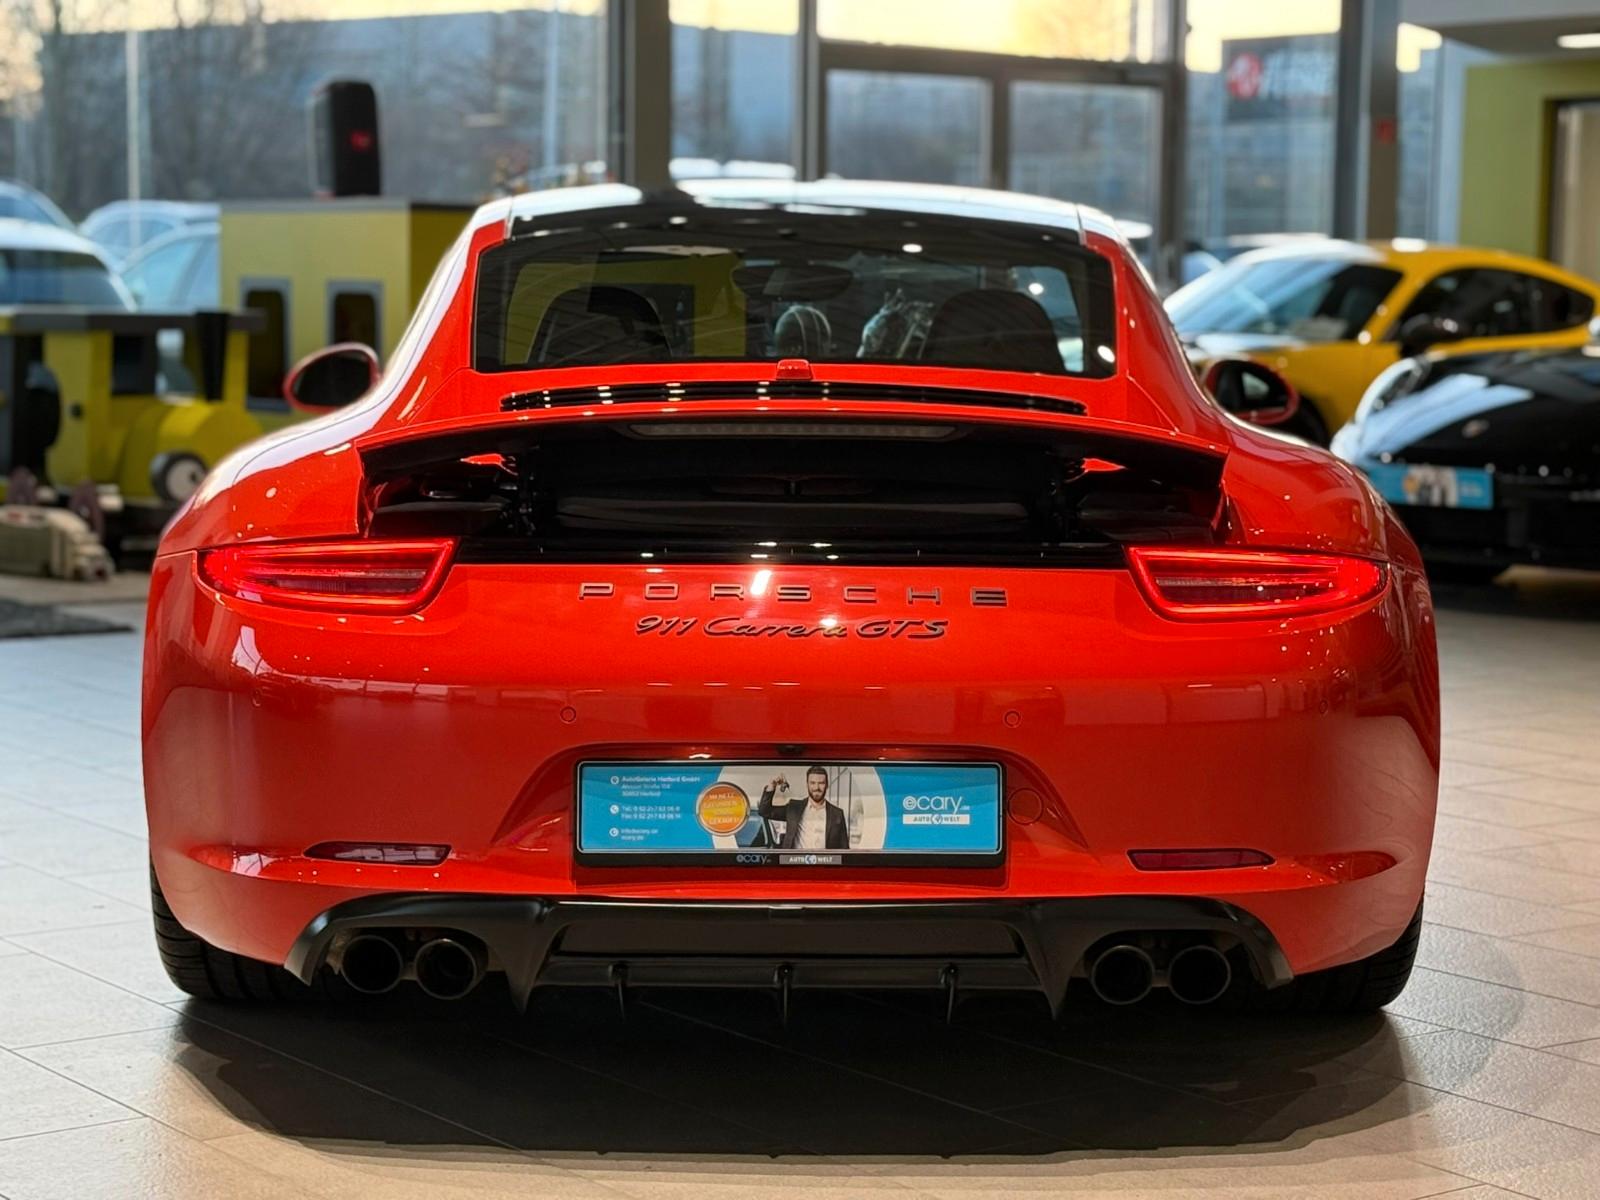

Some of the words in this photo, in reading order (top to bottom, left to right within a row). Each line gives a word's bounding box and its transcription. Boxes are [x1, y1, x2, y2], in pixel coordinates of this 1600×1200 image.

[579, 583, 1007, 606] PORSCHE
[636, 615, 697, 636] 911
[703, 617, 848, 638] Carrera
[856, 619, 949, 639] GTS
